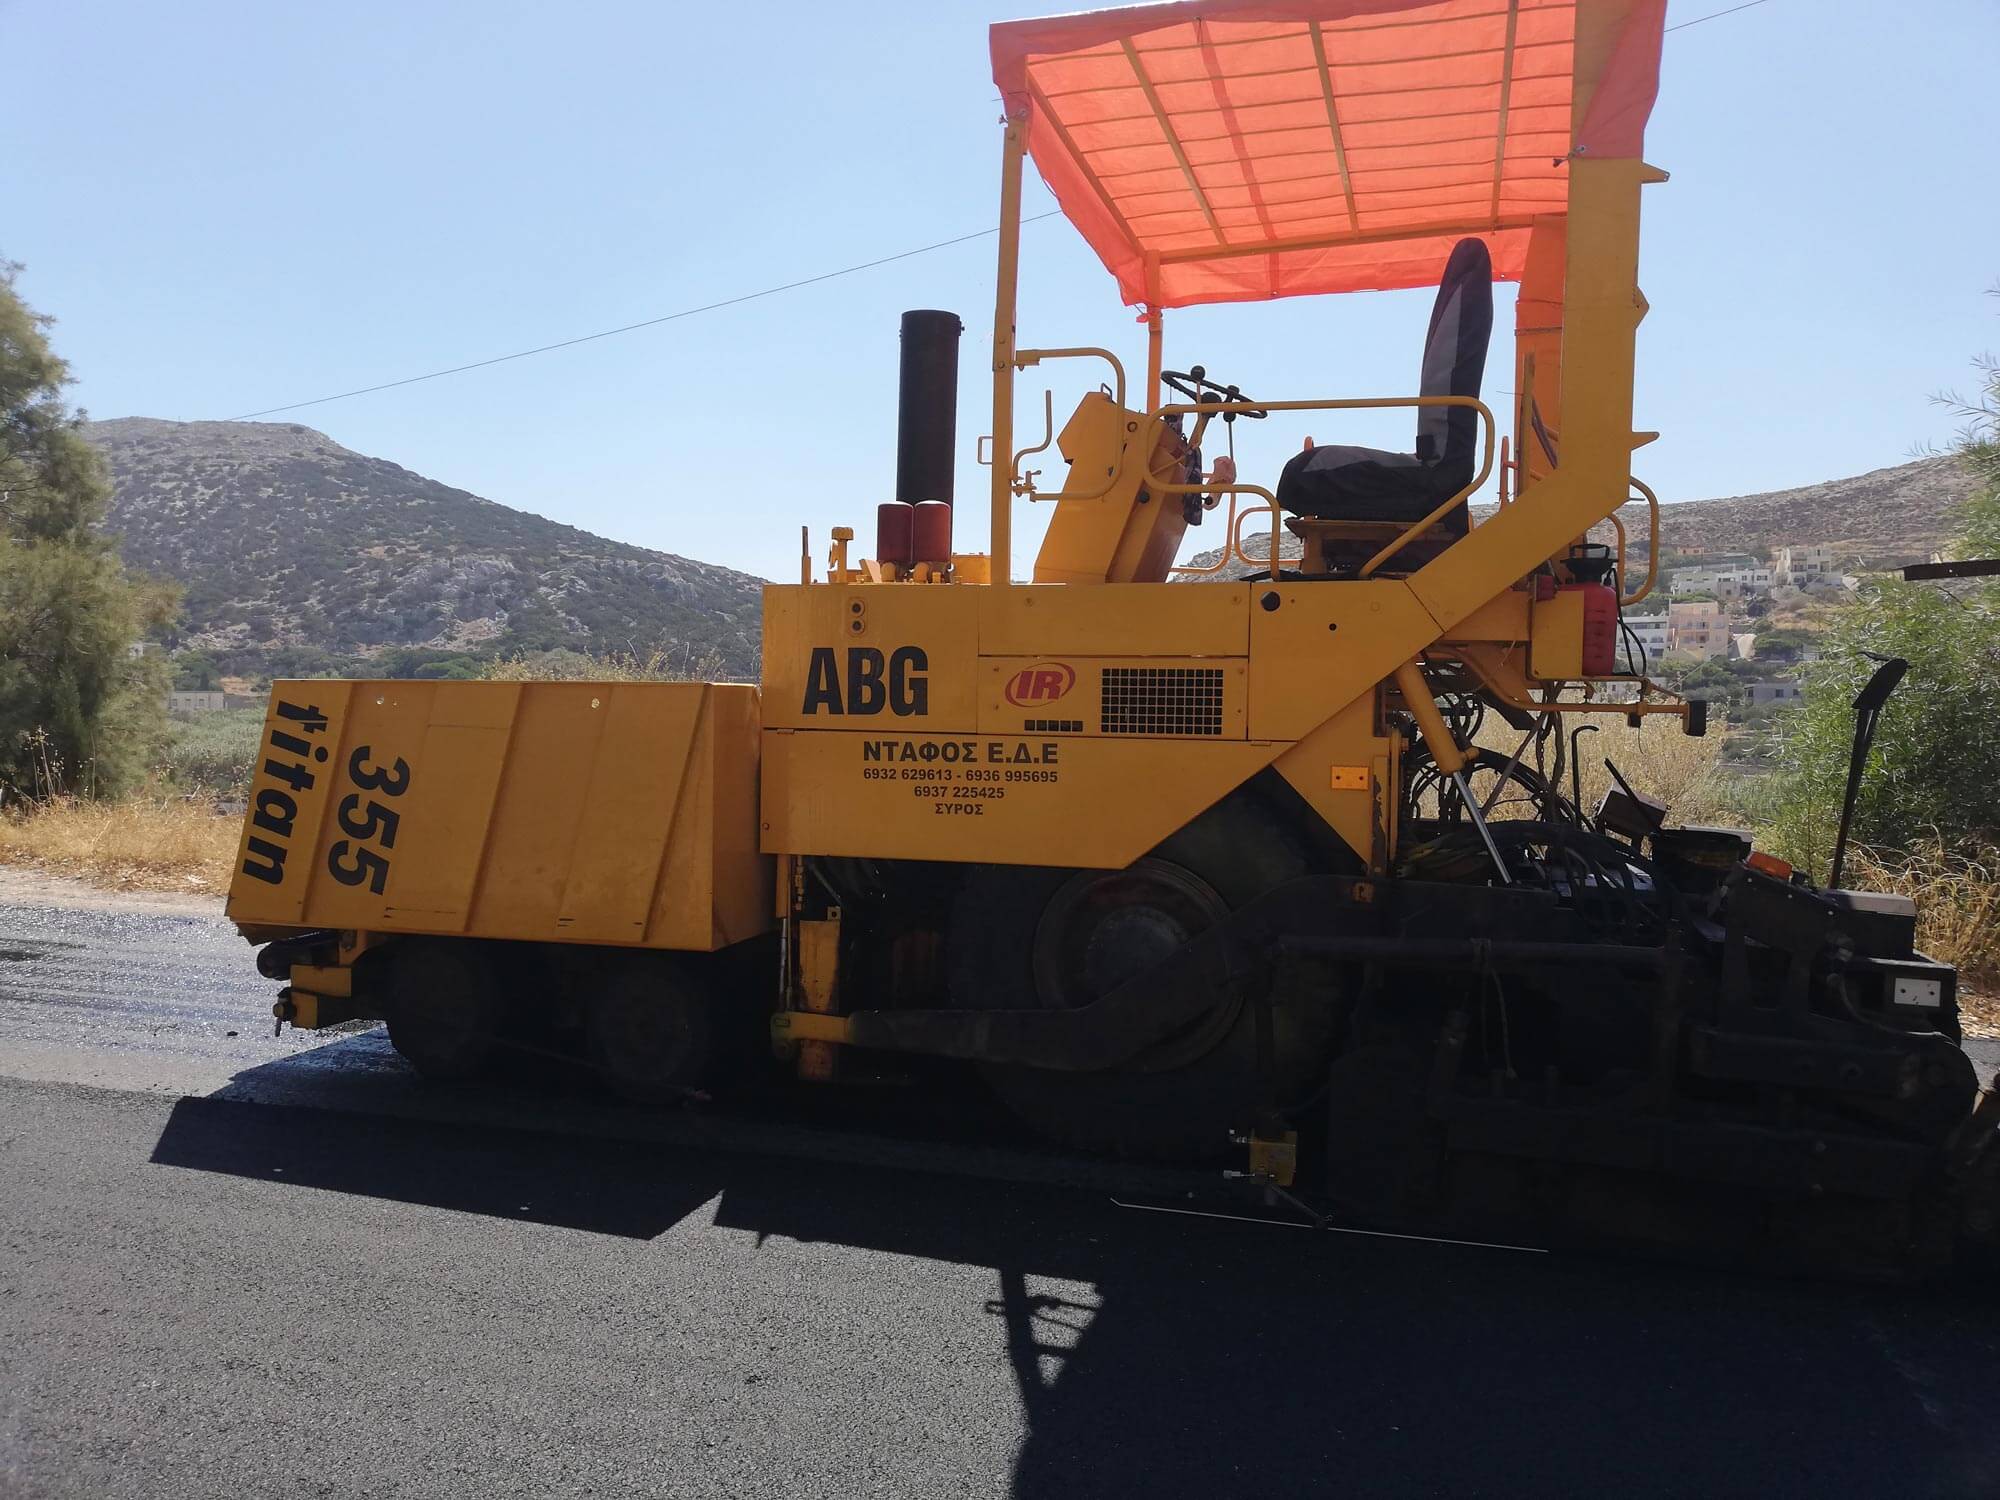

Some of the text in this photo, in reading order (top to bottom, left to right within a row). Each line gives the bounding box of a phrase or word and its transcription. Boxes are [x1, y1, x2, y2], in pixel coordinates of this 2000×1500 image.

[802, 646, 929, 716] ABG
[1015, 670, 1064, 700] IR
[863, 741, 1059, 764] ΝΤΑΦΟΣ Ε.Δ.Ε
[863, 768, 897, 780] 6932
[901, 768, 953, 781] 629613
[965, 769, 1000, 782] 6936
[1004, 770, 1058, 783] 995695
[241, 700, 329, 885] titan
[914, 785, 1005, 799] 6937 225425
[327, 745, 411, 897] 355
[935, 803, 984, 815] ΣΥΡΟΣ
